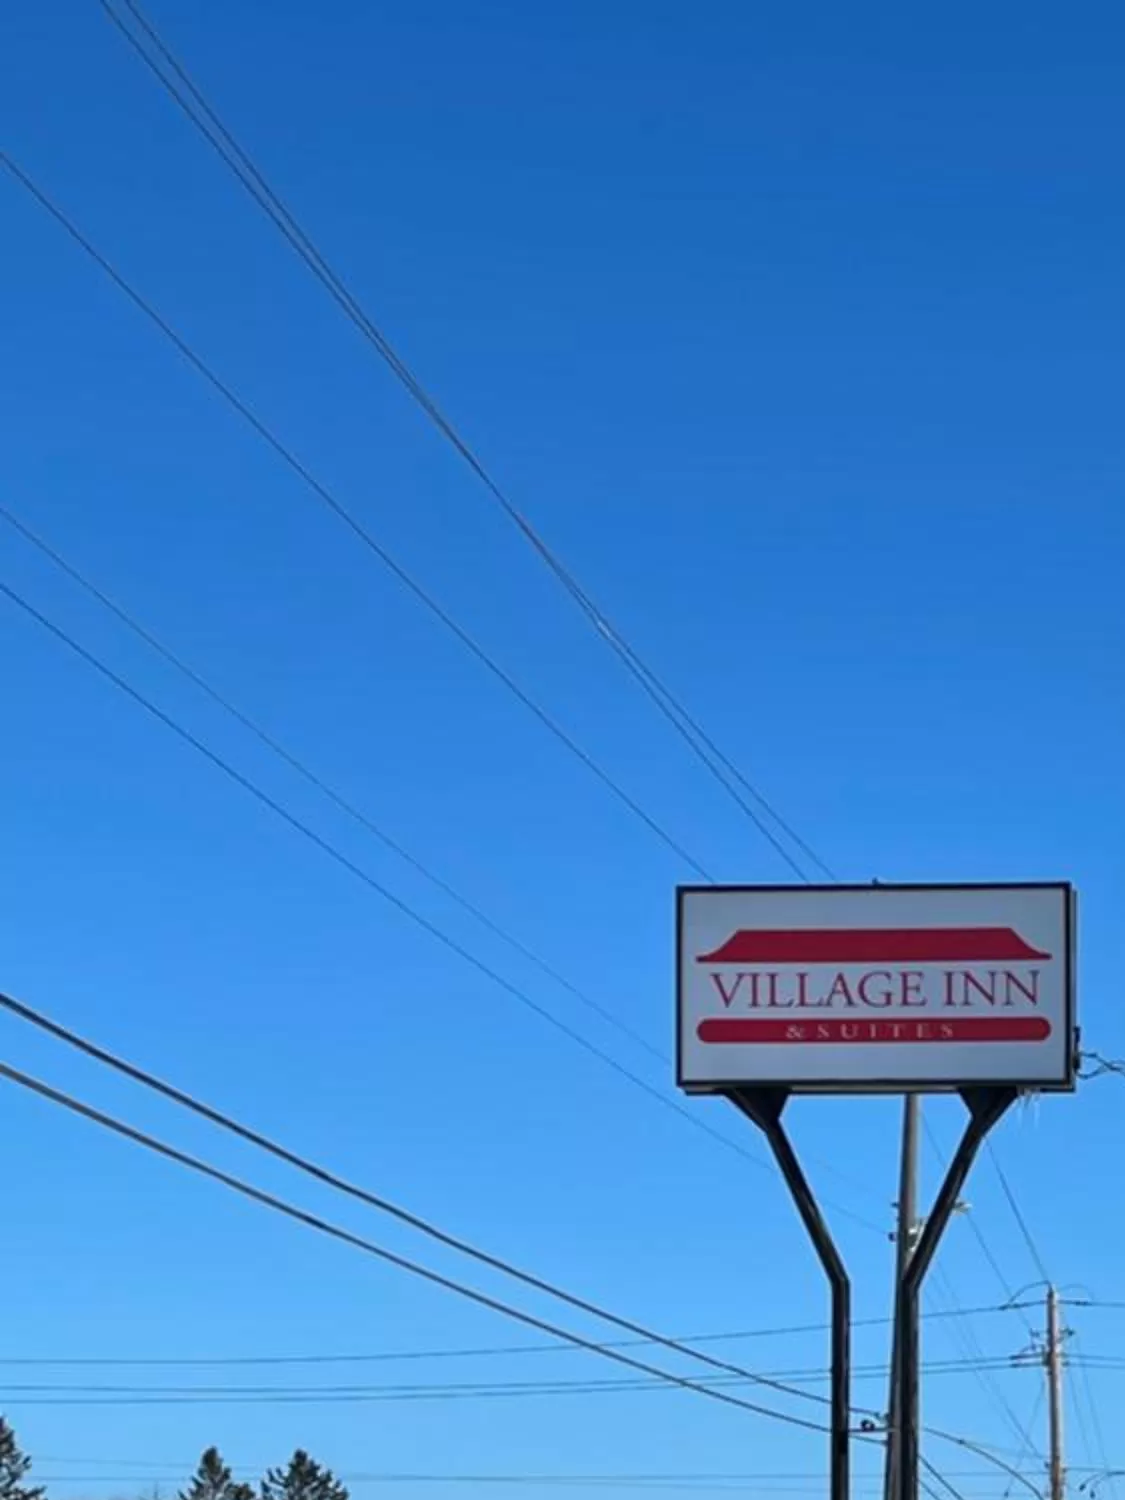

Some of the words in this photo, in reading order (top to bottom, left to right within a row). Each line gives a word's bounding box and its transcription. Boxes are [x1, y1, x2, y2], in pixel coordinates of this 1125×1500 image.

[710, 970, 928, 1008] VILLAGE
[943, 969, 1040, 1006] INN
[786, 1025, 803, 1038] &
[817, 1023, 954, 1038] SUITES
